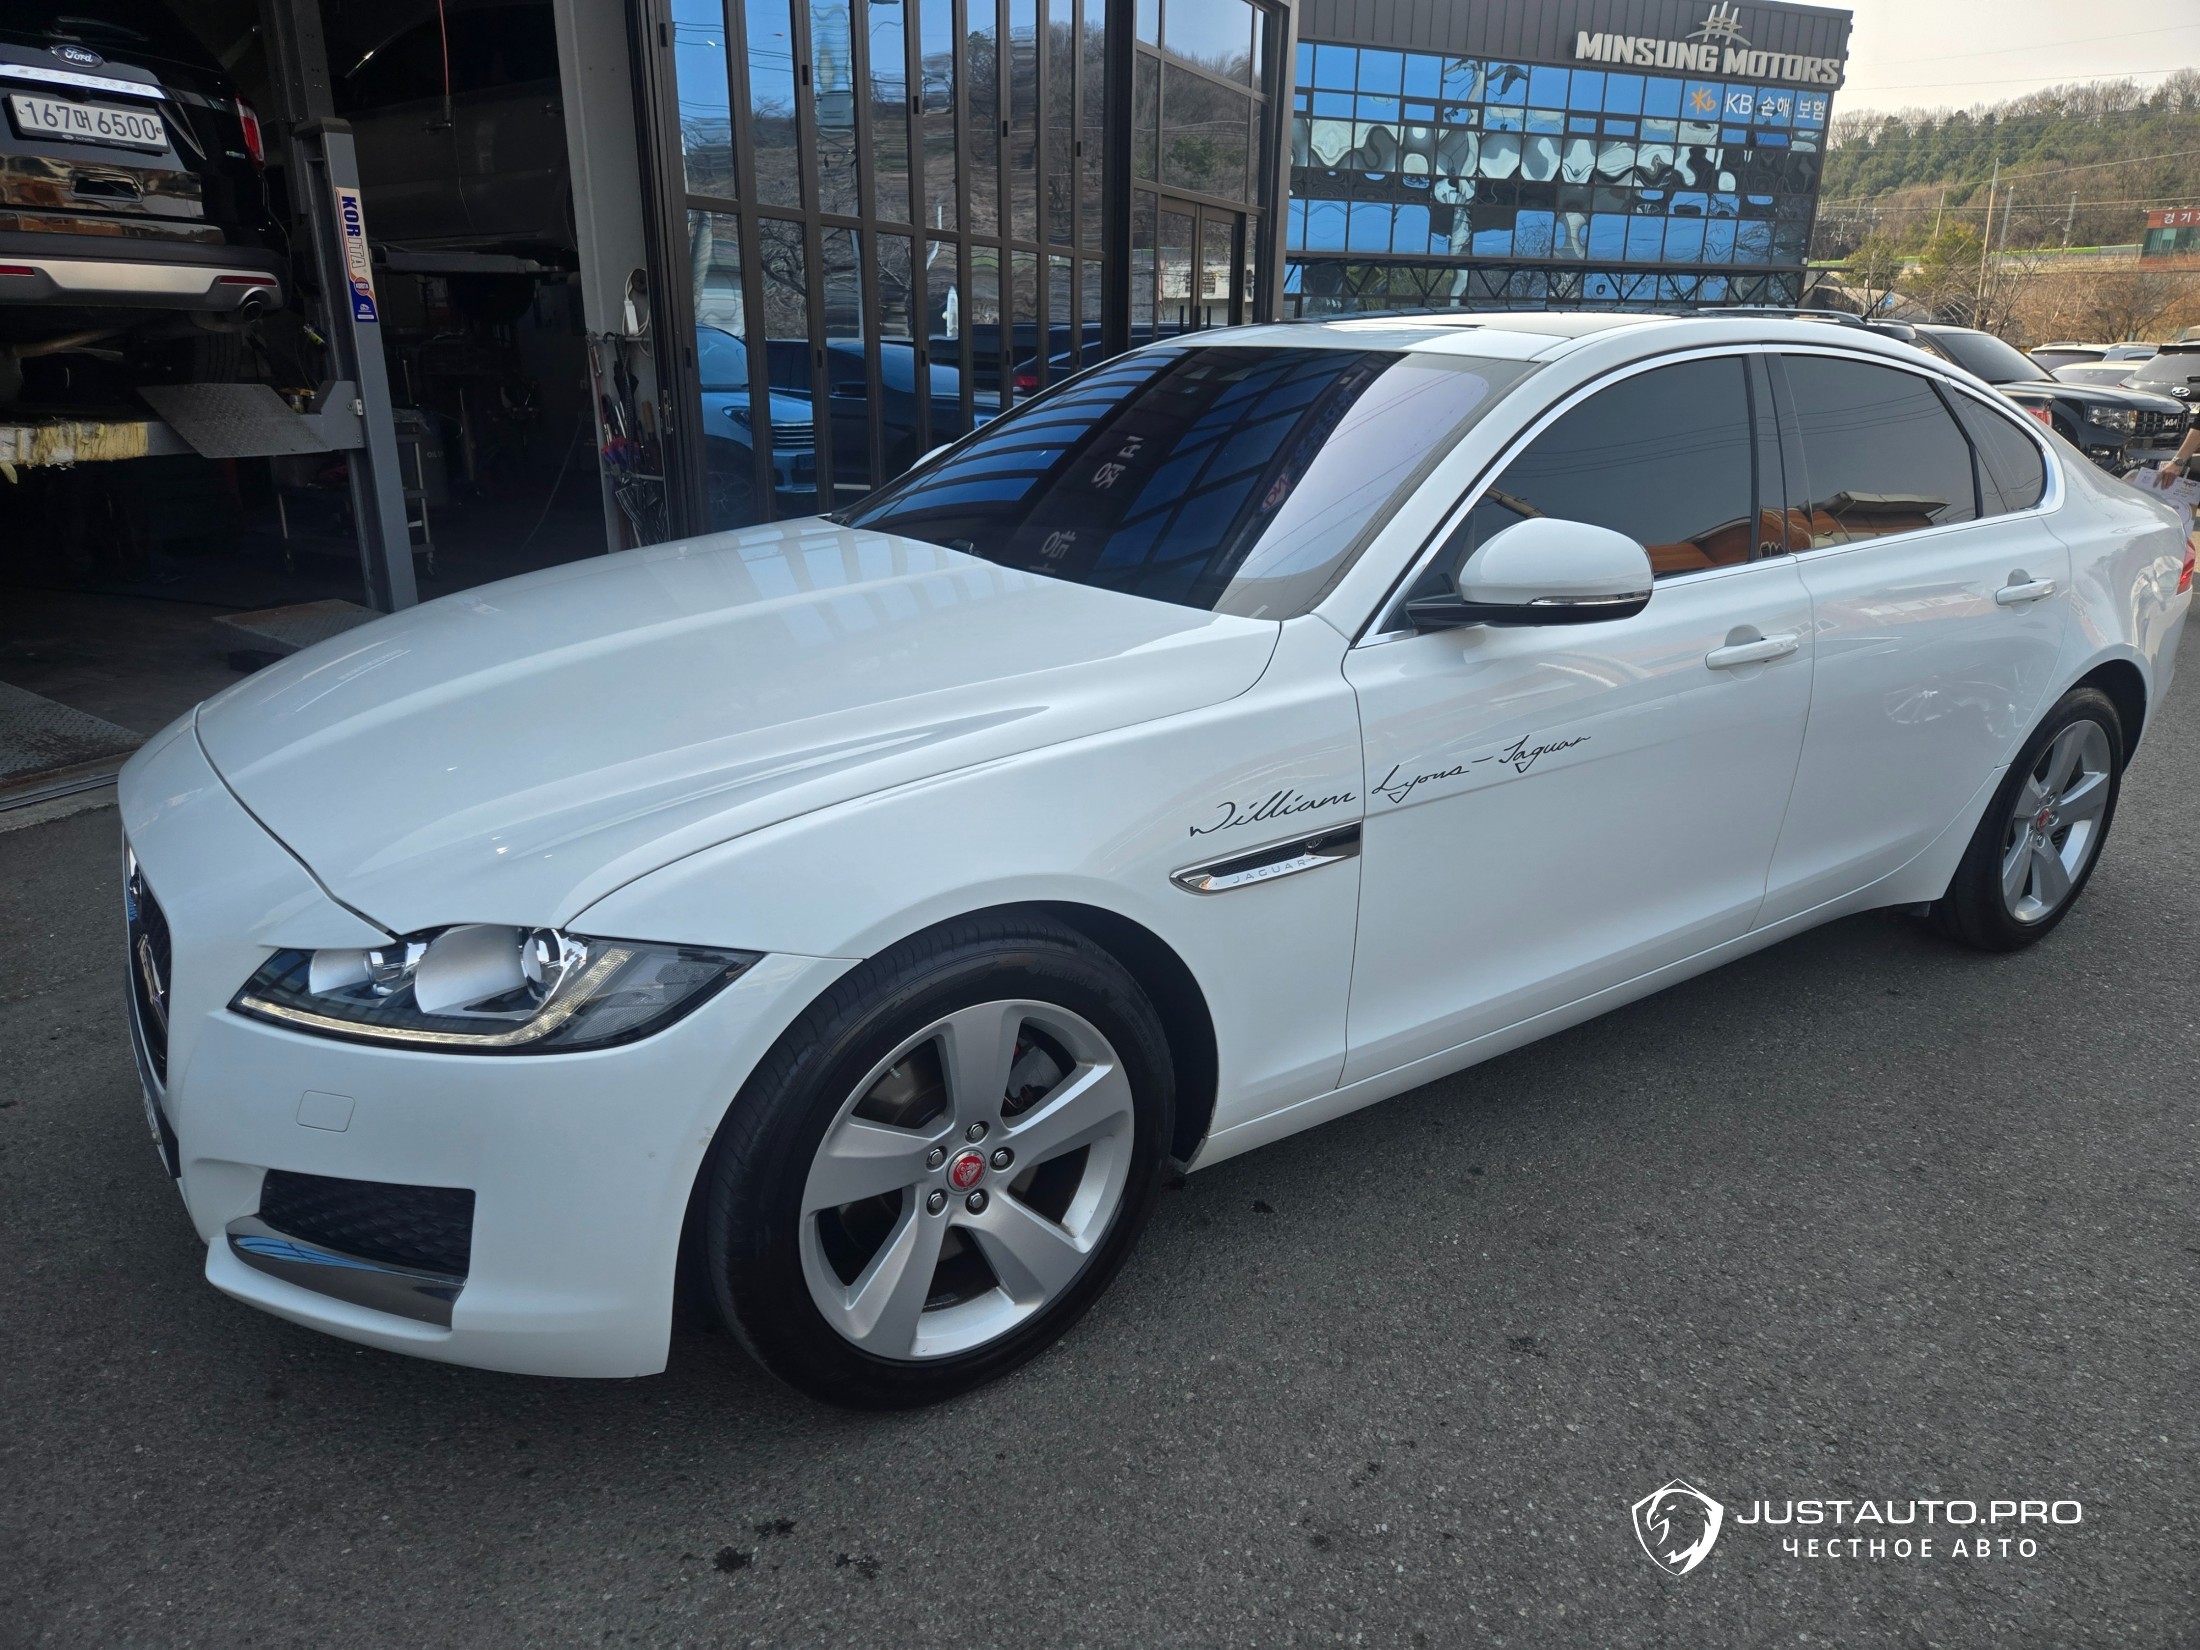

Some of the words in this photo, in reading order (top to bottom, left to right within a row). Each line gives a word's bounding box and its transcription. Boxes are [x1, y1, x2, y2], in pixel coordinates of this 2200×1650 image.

[64, 47, 94, 63] Ford
[1575, 30, 1719, 73] MINSUNG
[1722, 47, 1840, 84] MOTORS
[25, 101, 93, 132] 167머
[97, 111, 157, 141] 6500
[1725, 92, 1753, 115] KB
[1761, 96, 1790, 118] 손해
[1797, 100, 1826, 121] 보험
[341, 196, 366, 269] KORITA
[1189, 789, 1356, 837] William
[1371, 764, 1470, 804] Lyons
[1499, 734, 1592, 773] Jaguar
[1232, 858, 1307, 884] JAGUAR
